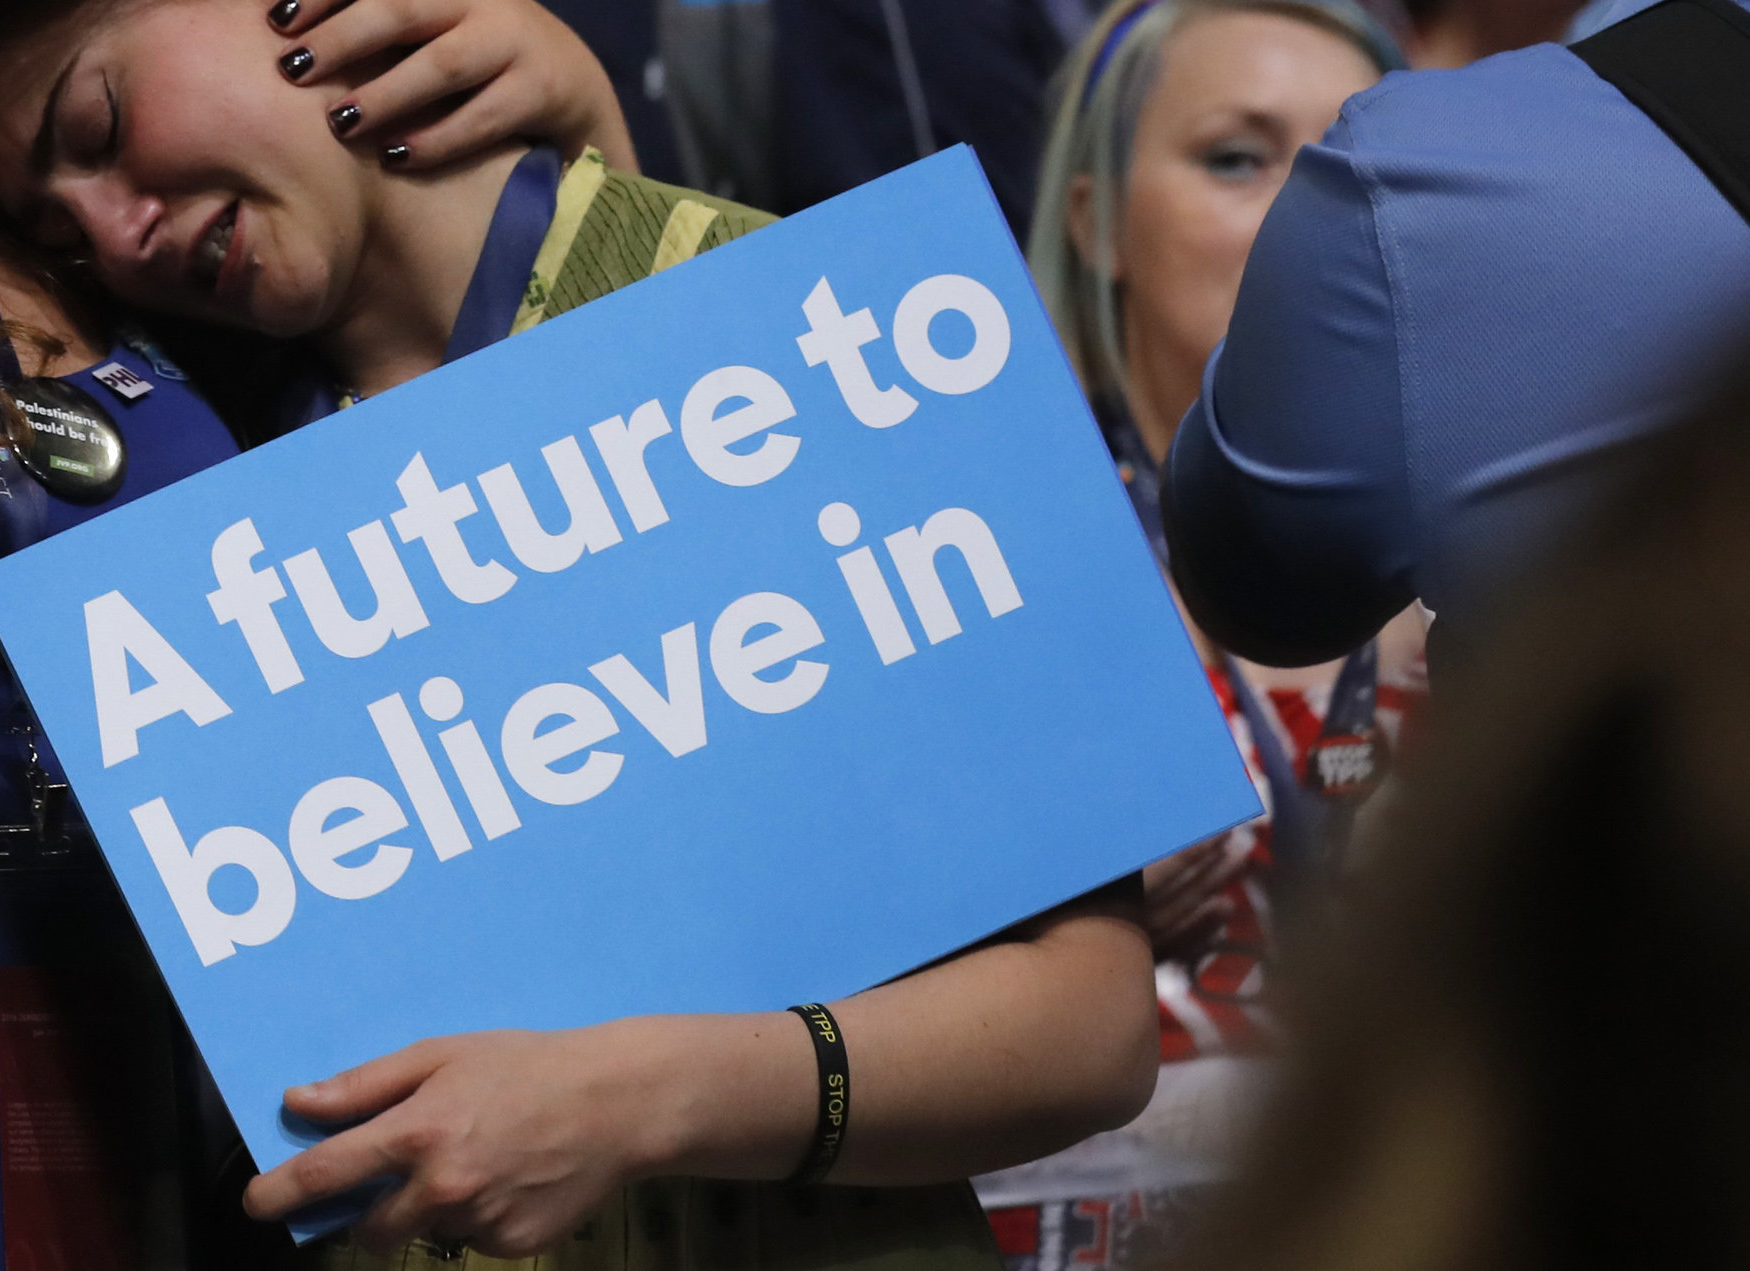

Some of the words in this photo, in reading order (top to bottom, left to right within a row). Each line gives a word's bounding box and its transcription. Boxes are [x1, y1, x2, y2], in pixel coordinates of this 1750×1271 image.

[15, 399, 99, 428] Palestinians
[25, 416, 66, 437] hould
[70, 426, 87, 442] be
[83, 589, 234, 769] A
[207, 365, 802, 694] future
[796, 274, 1011, 429] to
[129, 591, 830, 967] believe
[818, 502, 1024, 666] in
[811, 1011, 837, 1044] TPP
[827, 1073, 844, 1127] STOP
